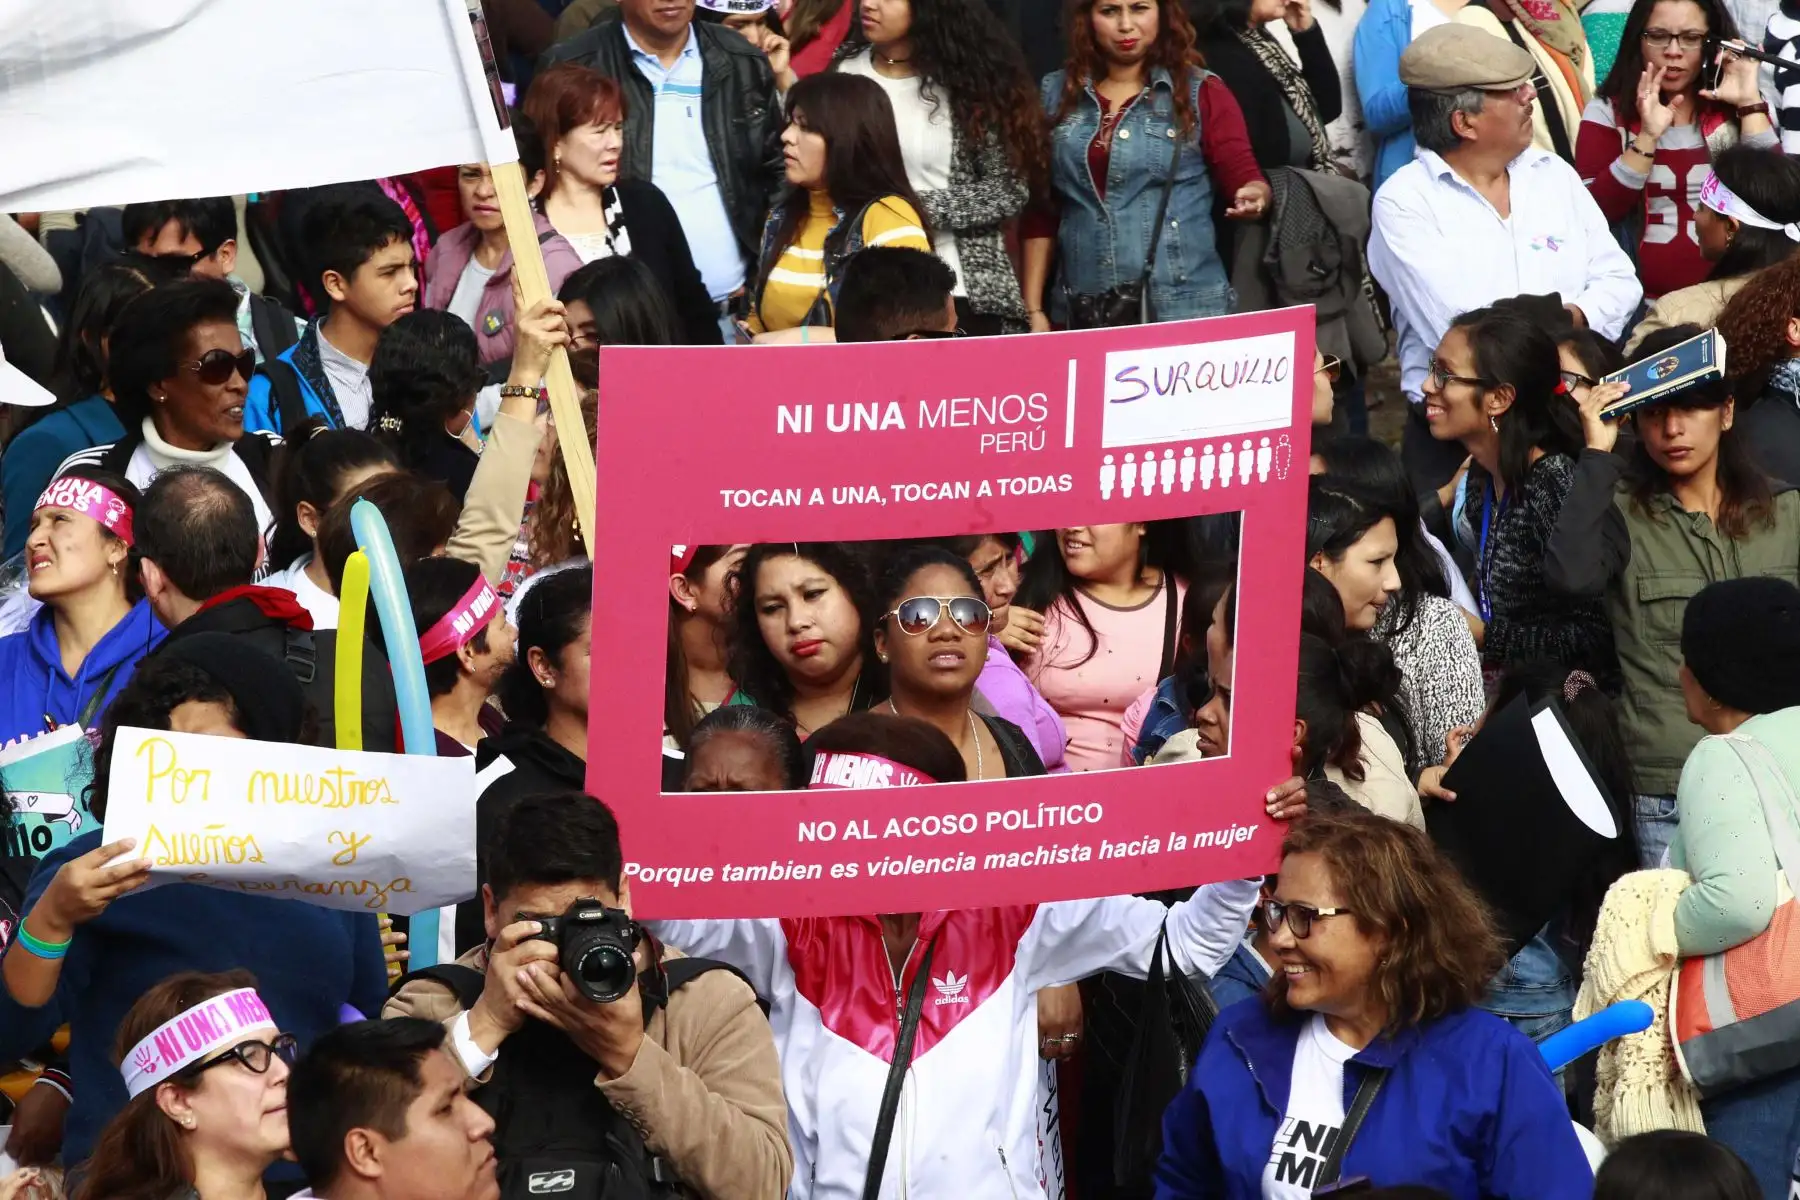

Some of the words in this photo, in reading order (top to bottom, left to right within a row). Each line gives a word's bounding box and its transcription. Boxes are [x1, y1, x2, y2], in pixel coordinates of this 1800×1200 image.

[778, 404, 813, 433] NI
[827, 402, 905, 432] UNA
[919, 393, 1048, 428] MENOS
[981, 425, 1046, 453] PERÚ
[719, 489, 802, 507] TOCAN
[808, 488, 825, 505] A
[833, 486, 887, 505] UNA,
[891, 481, 970, 501] TOCAN
[977, 480, 993, 497] A
[997, 474, 1073, 495] TODAS
[136, 737, 211, 804] Por
[247, 765, 400, 808] nuestros
[799, 821, 837, 841] NO
[843, 820, 878, 840] AL
[883, 814, 978, 838] ACOSO
[986, 803, 1103, 832] POLÍTICO
[622, 862, 714, 888] Porque
[722, 861, 822, 882] tambien
[831, 863, 859, 879] es
[868, 852, 977, 877] violencia
[984, 844, 1092, 870] machista
[1099, 835, 1161, 860] hacia
[1167, 832, 1187, 852] la
[1194, 824, 1259, 849] mujer
[934, 993, 970, 1006] adidas
[154, 1026, 187, 1067] NI
[1287, 1119, 1341, 1158] NI
[1274, 1151, 1325, 1190] M
